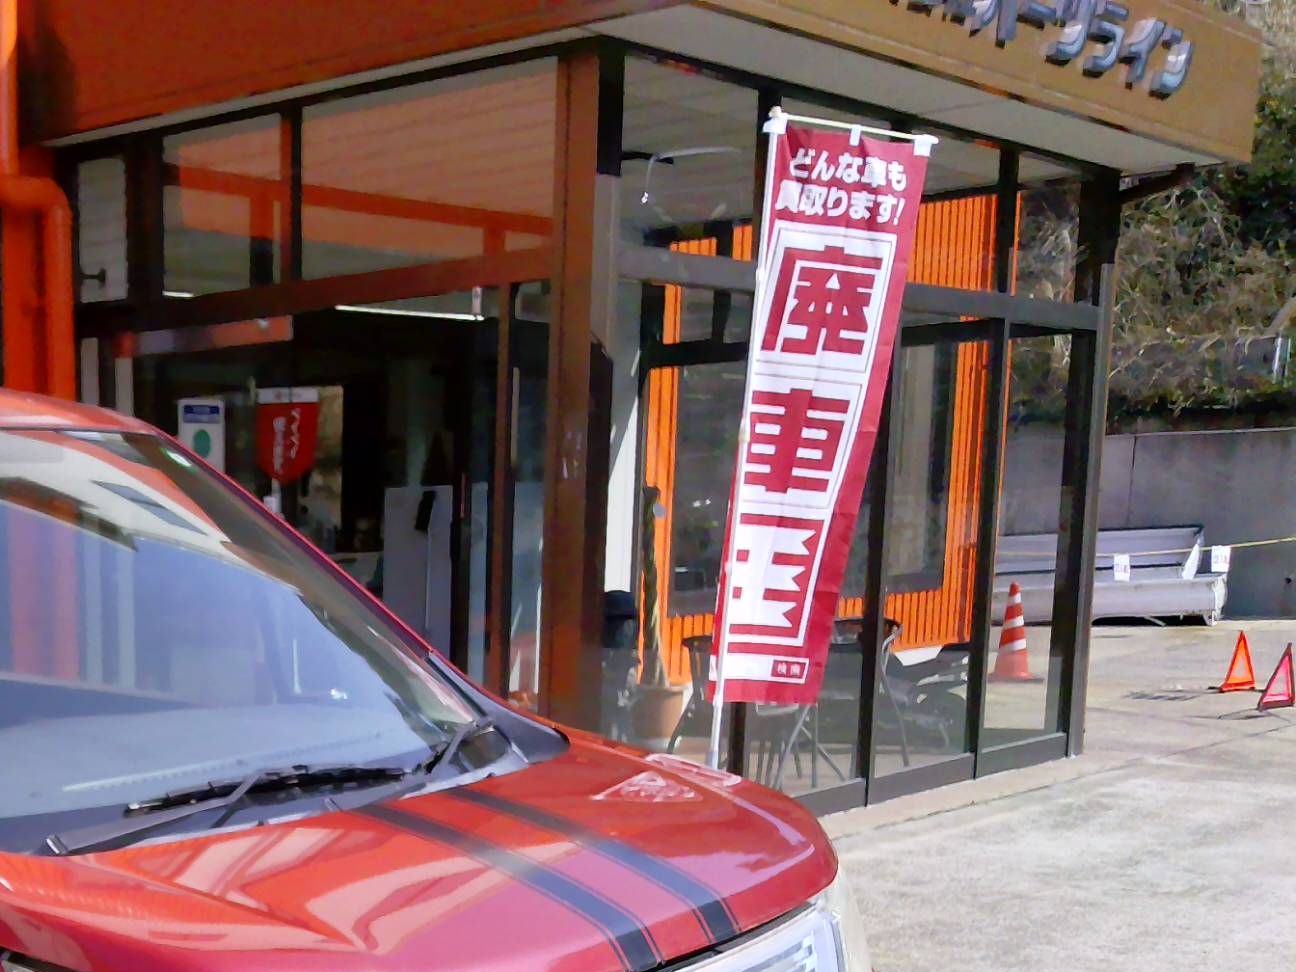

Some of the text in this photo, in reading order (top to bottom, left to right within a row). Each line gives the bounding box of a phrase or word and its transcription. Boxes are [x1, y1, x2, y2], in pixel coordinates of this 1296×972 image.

[789, 147, 907, 192] どんな車も
